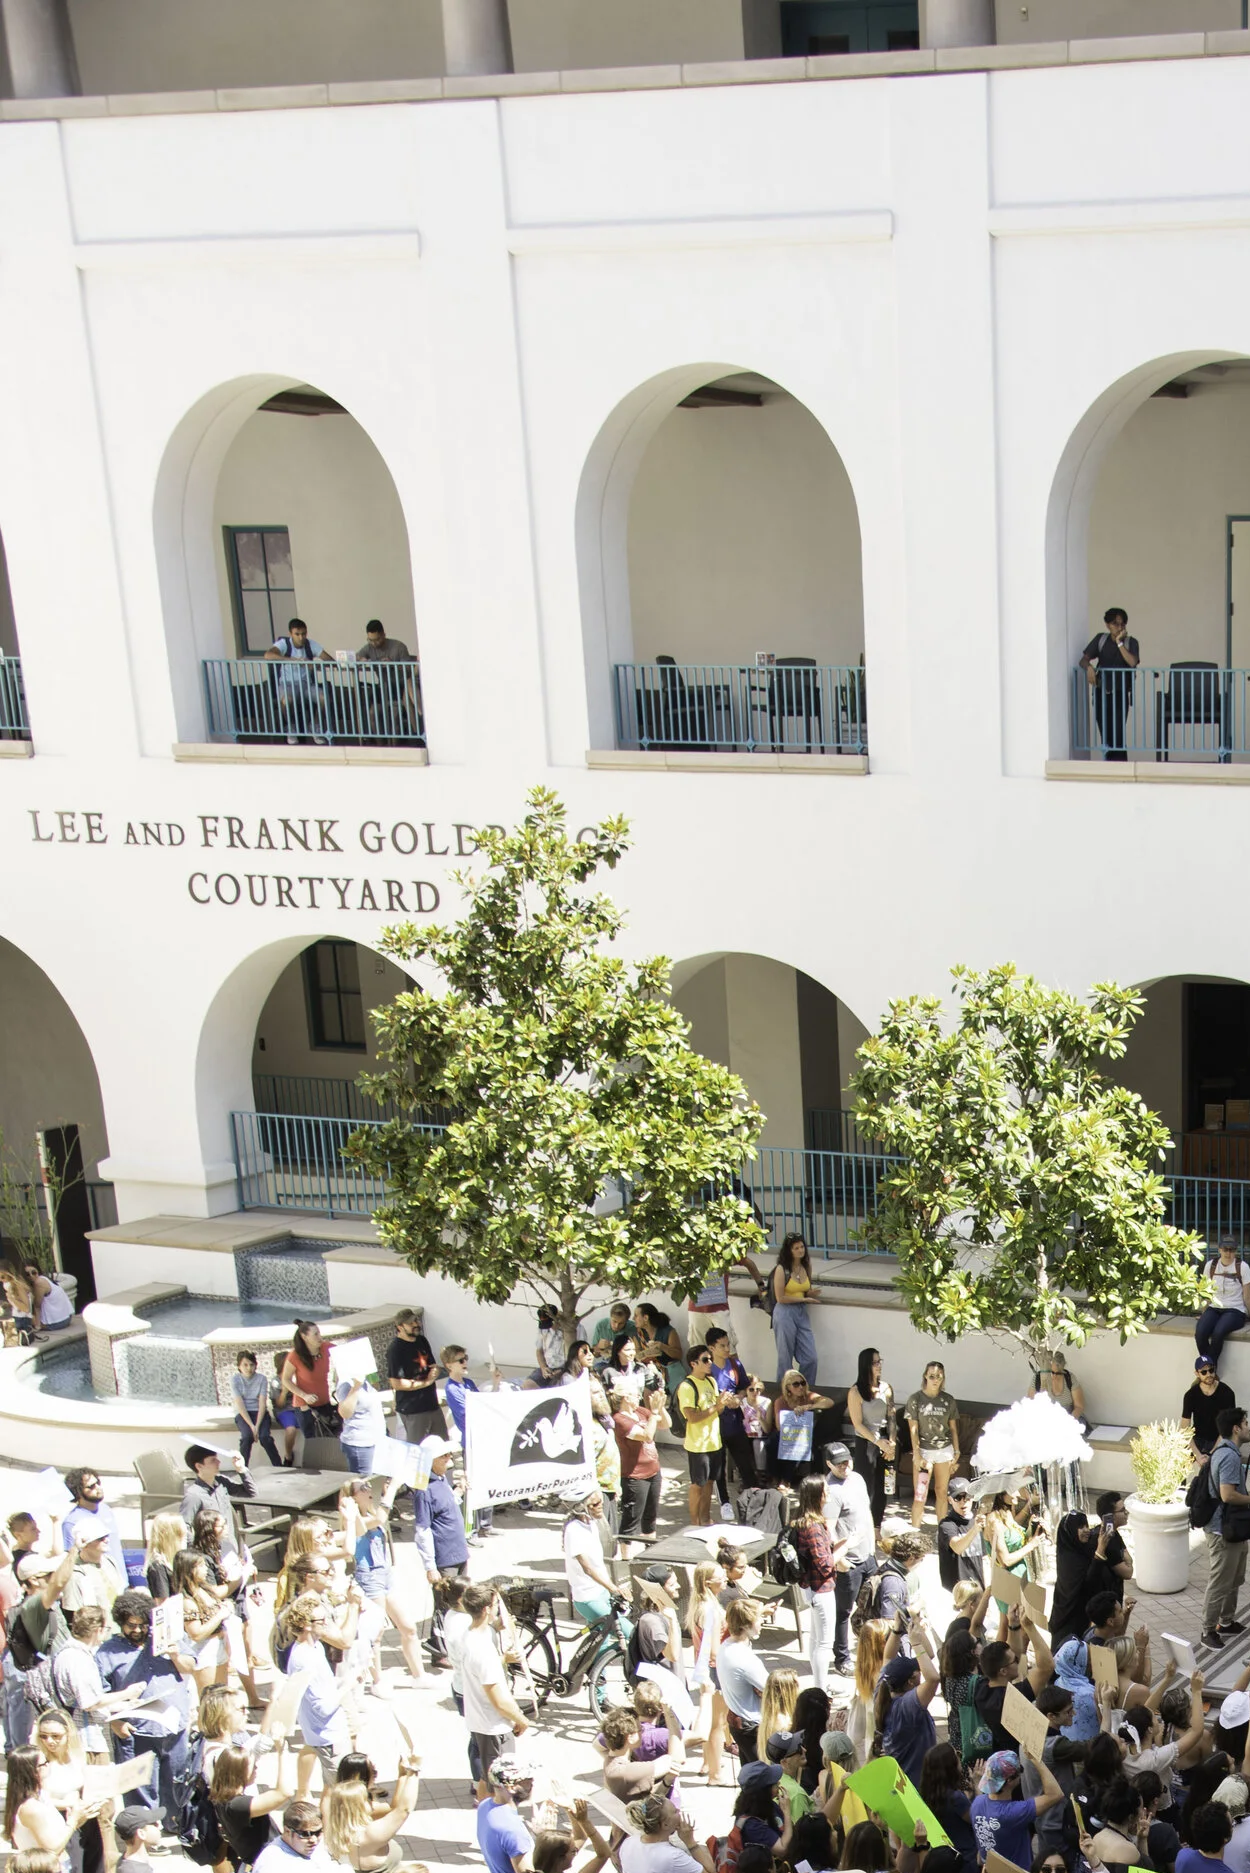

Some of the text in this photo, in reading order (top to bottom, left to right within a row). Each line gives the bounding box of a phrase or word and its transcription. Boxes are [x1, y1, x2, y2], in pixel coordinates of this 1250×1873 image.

[28, 810, 109, 844] LEE
[124, 822, 186, 847] AND
[198, 815, 344, 853] FRANK
[188, 872, 441, 914] COURTYARD
